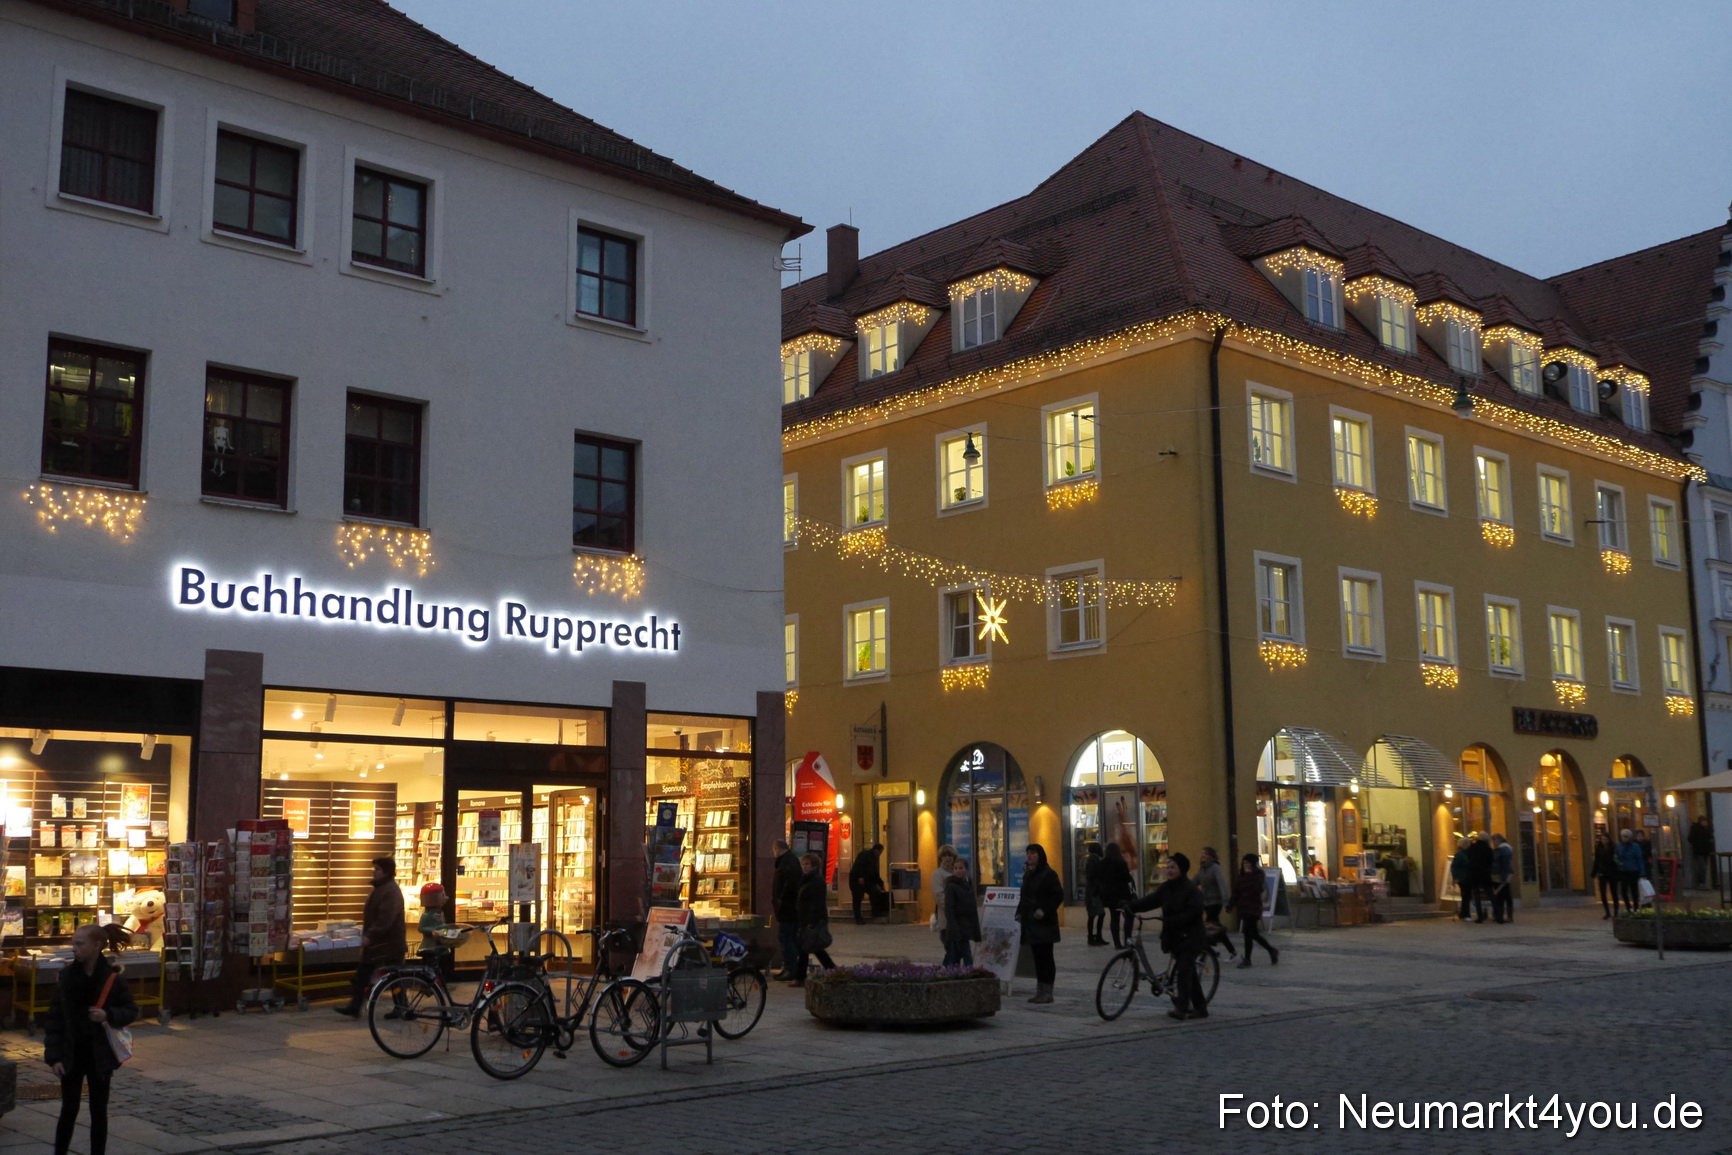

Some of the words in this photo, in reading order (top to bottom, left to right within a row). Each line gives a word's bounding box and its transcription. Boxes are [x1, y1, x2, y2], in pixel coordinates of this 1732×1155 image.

[179, 567, 490, 642] Buchhandlung
[505, 601, 682, 651] Rupprecht
[1101, 761, 1135, 772] hailer
[662, 785, 687, 794] Spannung
[701, 781, 737, 791] Empfehlungen
[801, 800, 823, 808] Exklusiv
[823, 799, 832, 807] für
